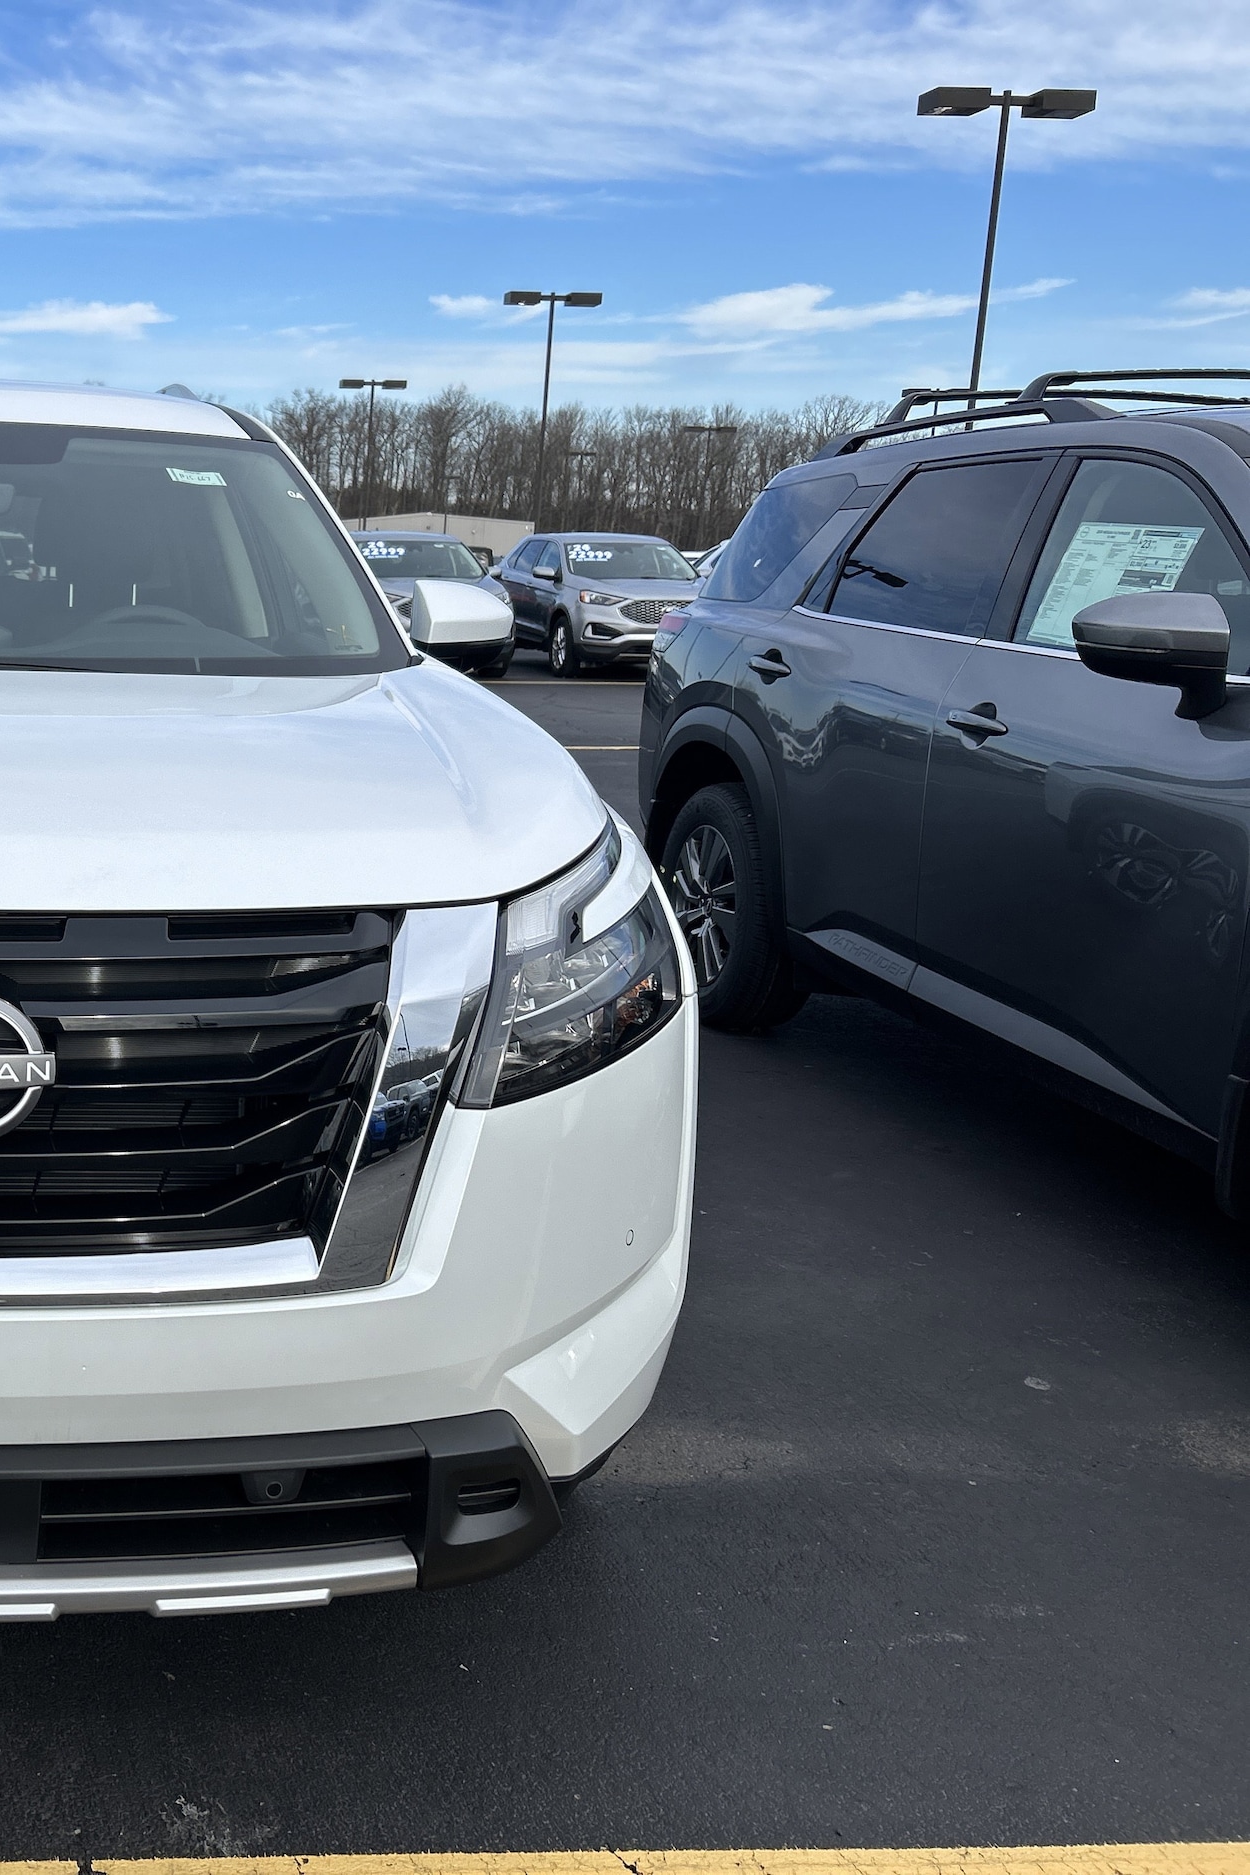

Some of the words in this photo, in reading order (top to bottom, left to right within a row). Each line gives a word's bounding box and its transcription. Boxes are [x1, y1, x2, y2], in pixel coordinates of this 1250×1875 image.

[361, 547, 406, 556] 22999
[568, 550, 613, 560] 22999
[828, 932, 909, 977] PATHFINDER
